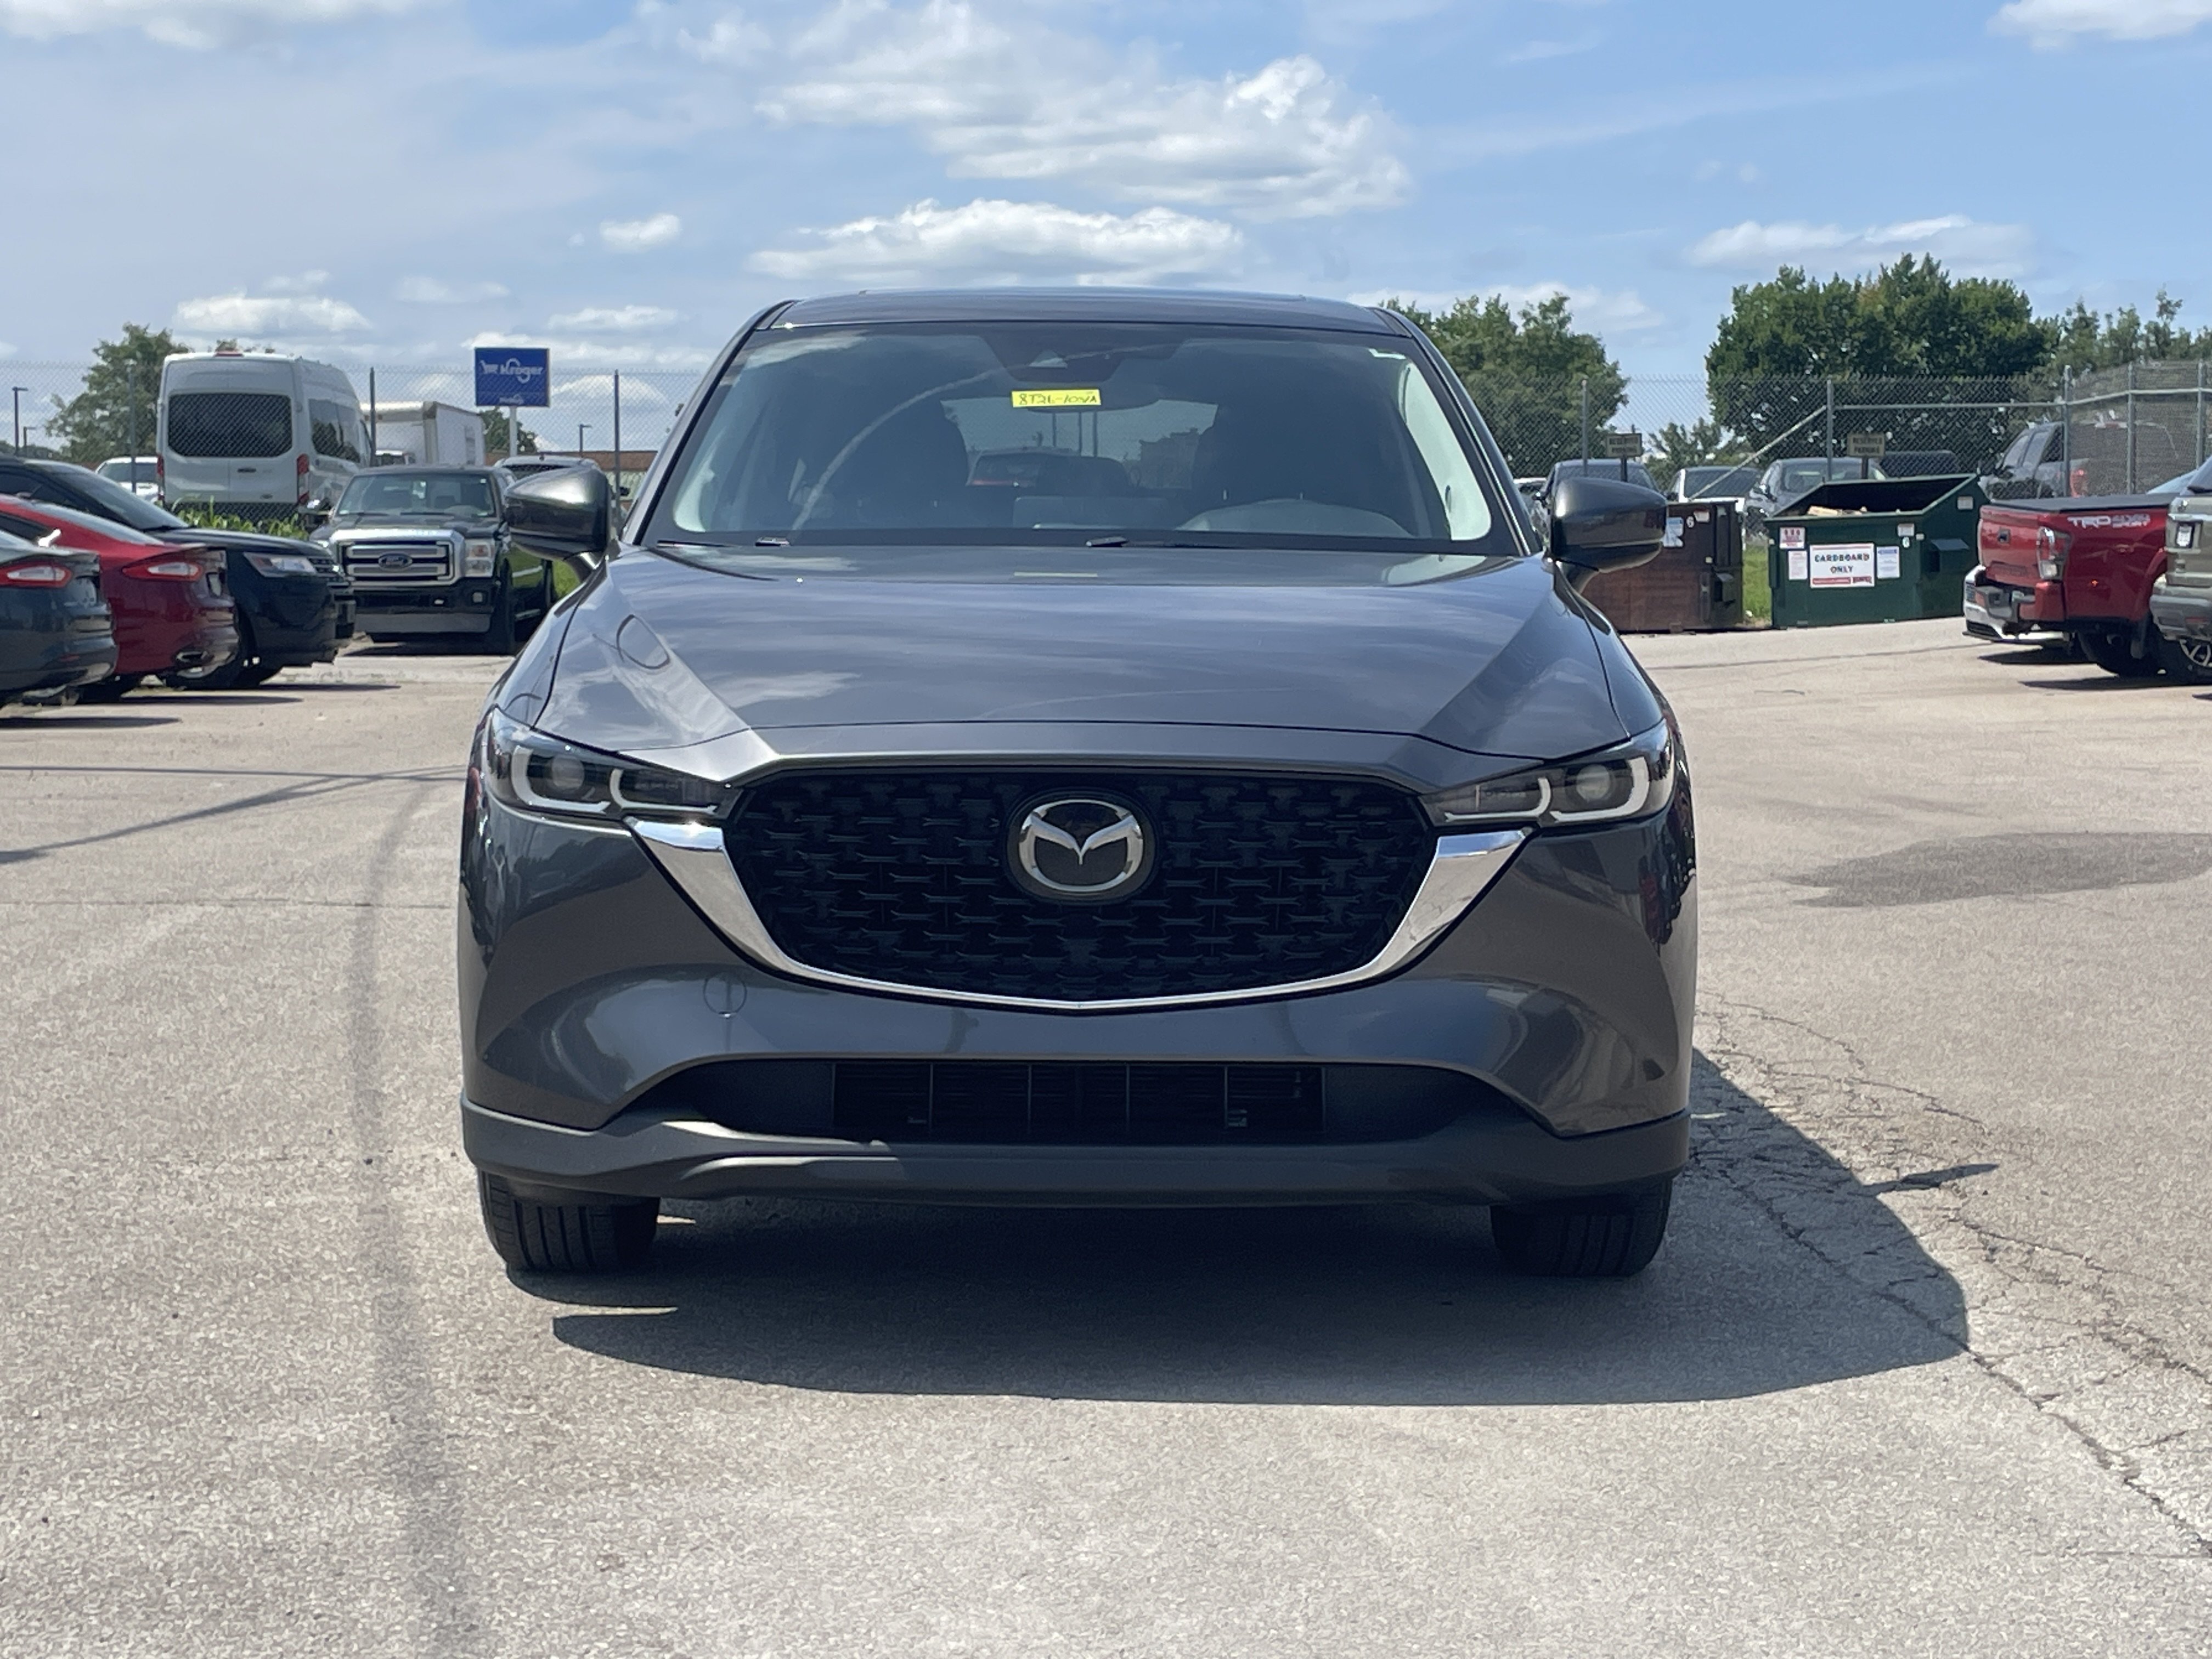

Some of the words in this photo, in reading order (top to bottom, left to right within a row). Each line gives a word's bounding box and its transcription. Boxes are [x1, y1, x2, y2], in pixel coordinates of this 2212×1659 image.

[500, 358, 544, 383] Kroger
[2067, 515, 2111, 528] TRD
[1814, 552, 1870, 562] CARDBOARD
[1830, 565, 1853, 574] ONLY
